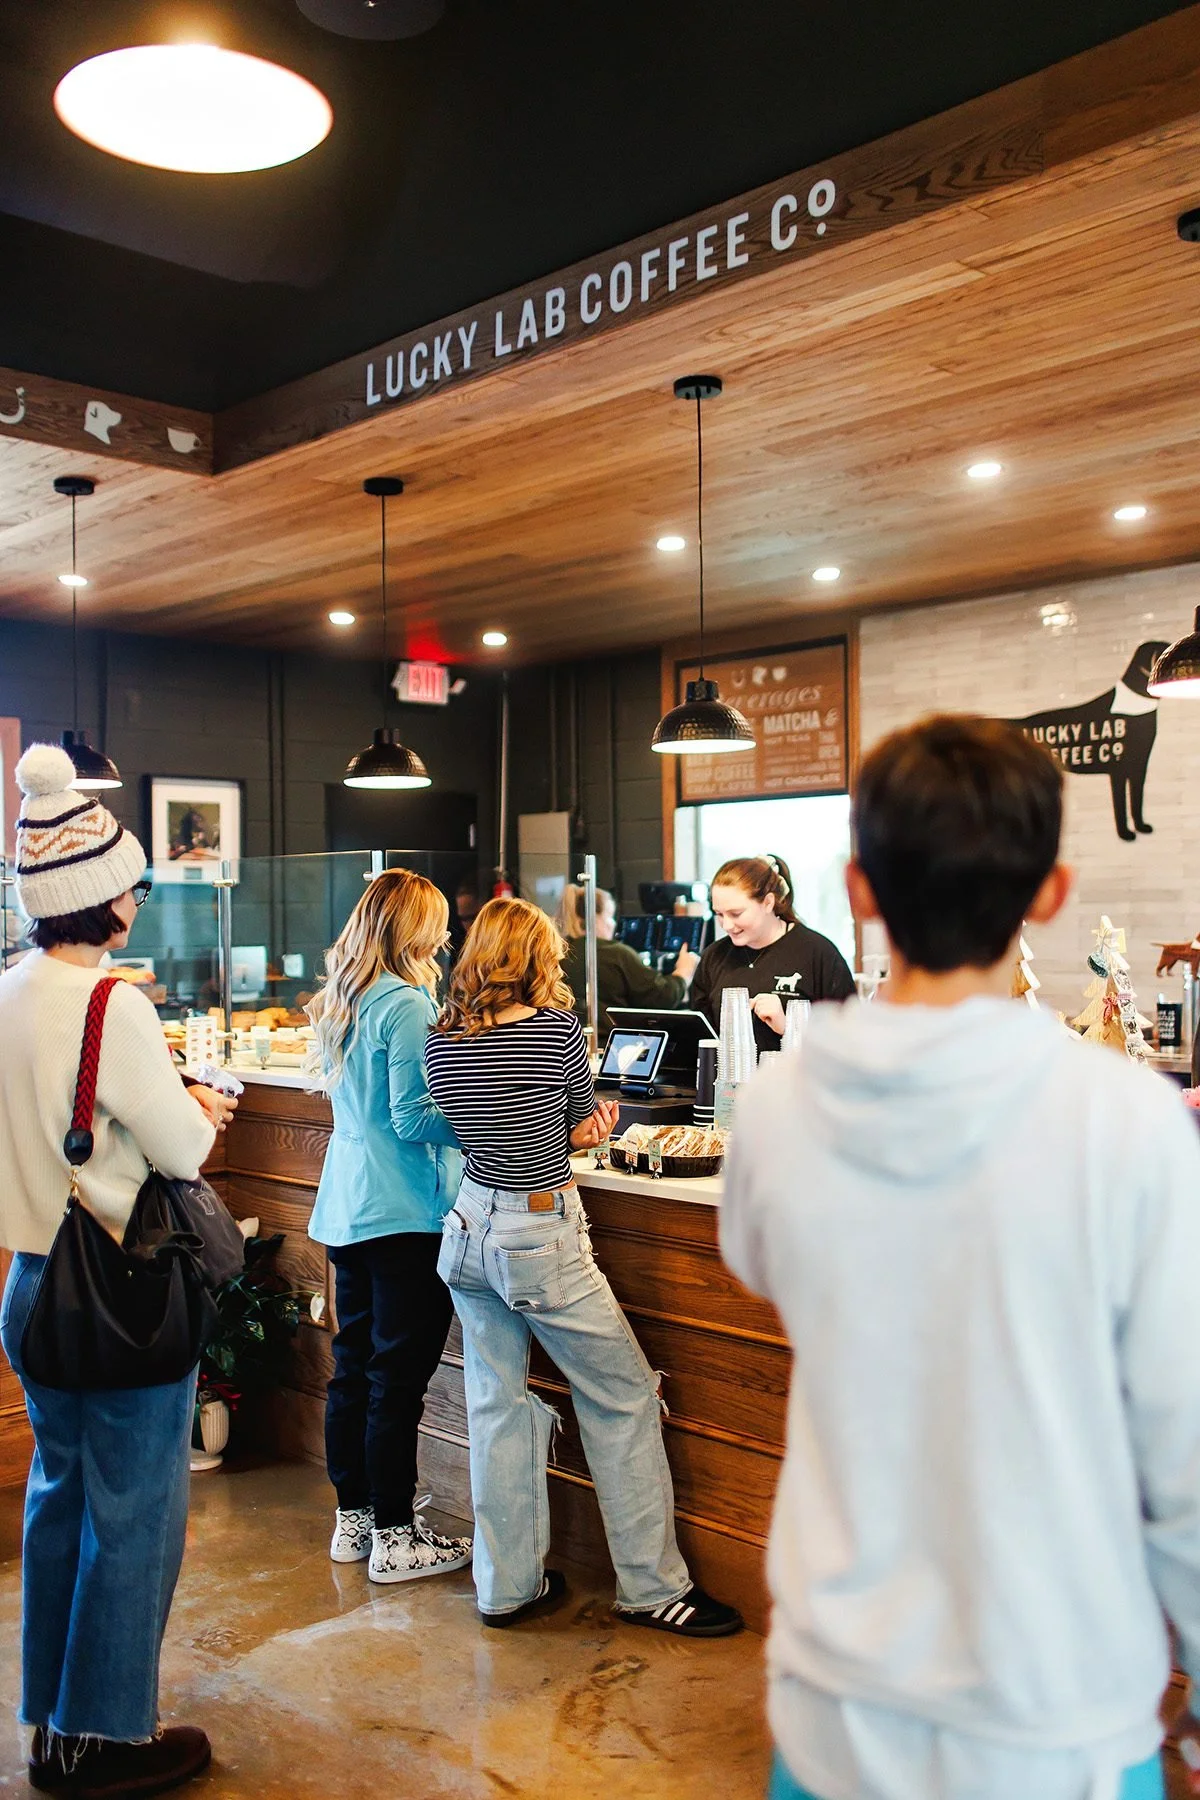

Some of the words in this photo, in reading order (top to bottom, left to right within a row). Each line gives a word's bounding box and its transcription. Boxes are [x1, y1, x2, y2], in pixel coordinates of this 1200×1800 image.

[366, 321, 478, 407] LUCKY
[495, 286, 565, 357] LAB
[580, 212, 750, 324] COFFEE
[408, 665, 444, 701] EXIT
[763, 710, 822, 734] MATCHA
[1089, 718, 1126, 741] LAB
[1050, 745, 1093, 766] FFEE
